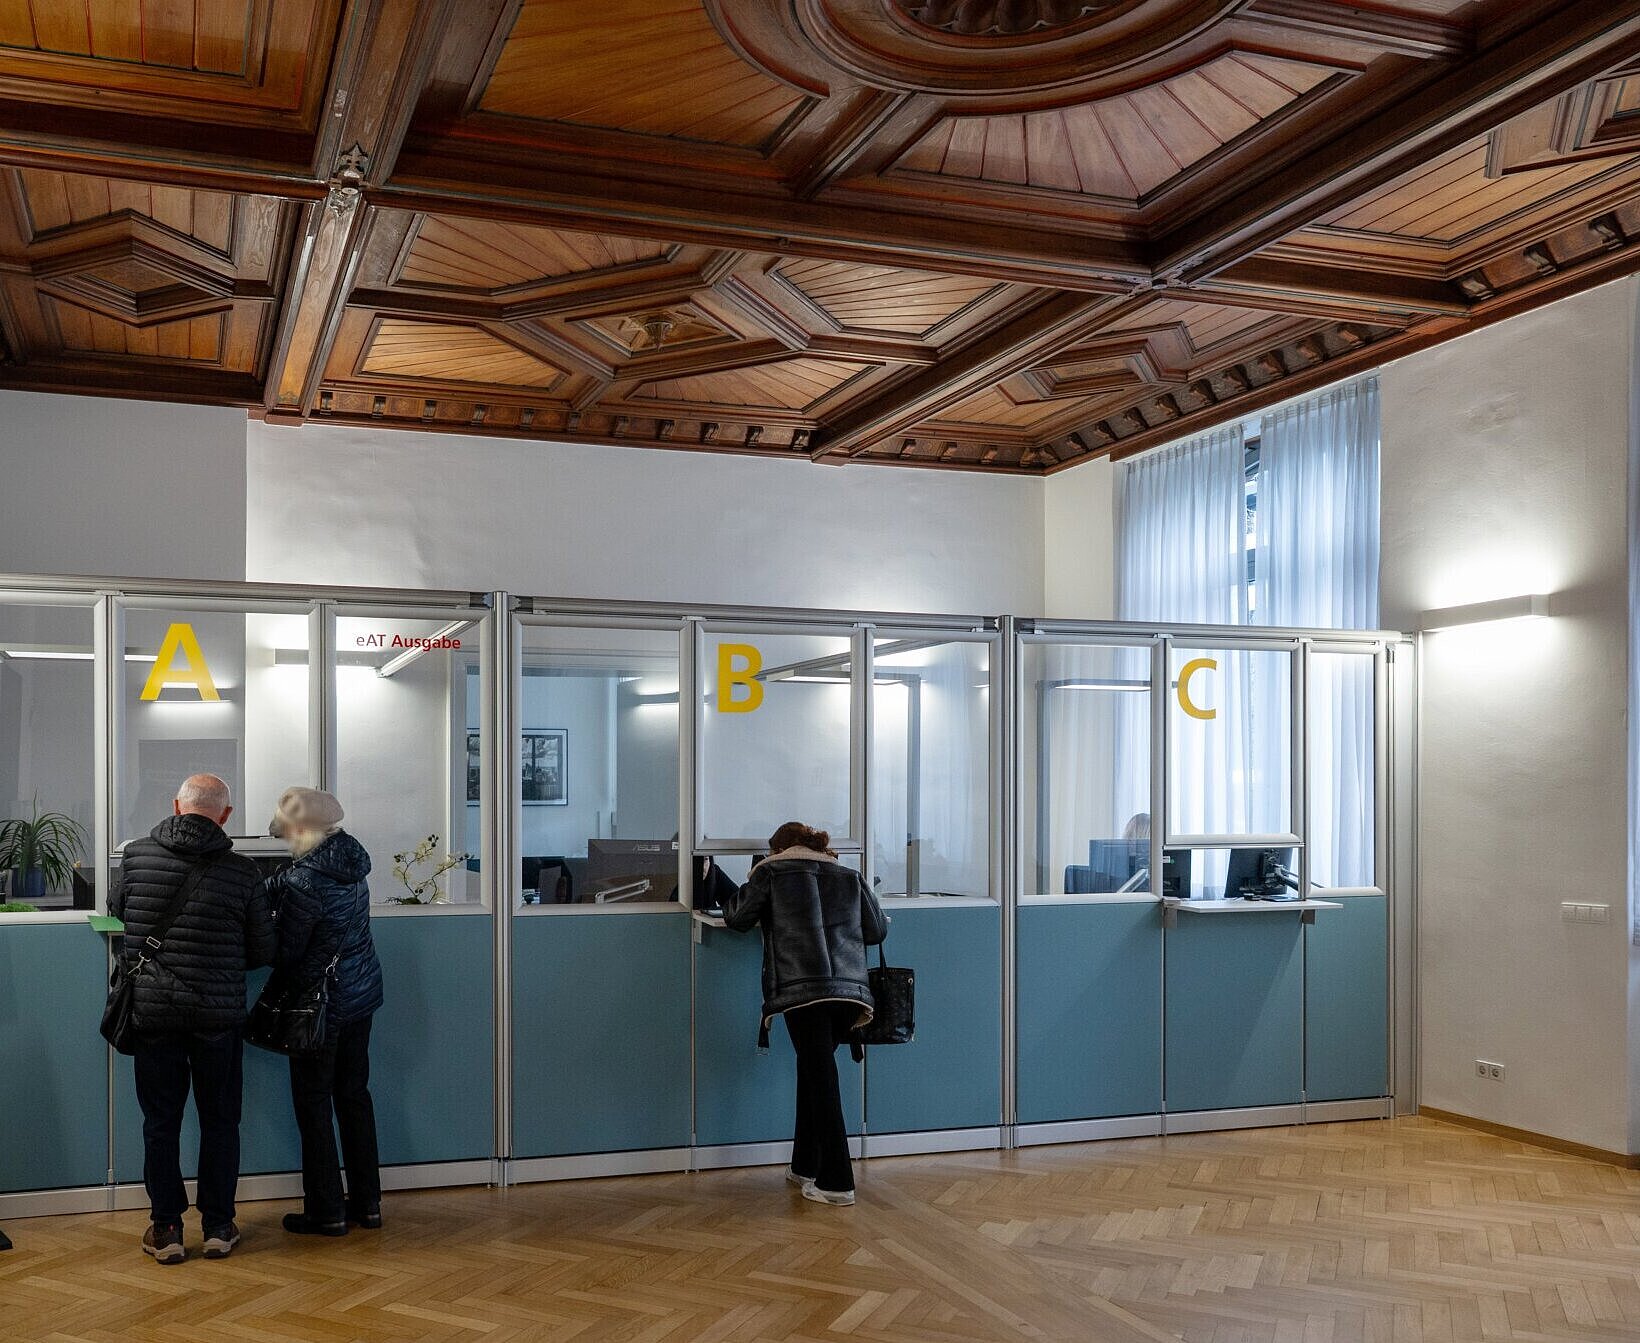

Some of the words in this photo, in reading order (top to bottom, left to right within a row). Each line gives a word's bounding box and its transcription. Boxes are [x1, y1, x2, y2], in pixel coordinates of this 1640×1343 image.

[140, 623, 220, 701] A
[356, 634, 386, 647] eAT
[391, 635, 461, 652] Ausgabe
[718, 644, 764, 713] B
[1177, 658, 1217, 719] C
